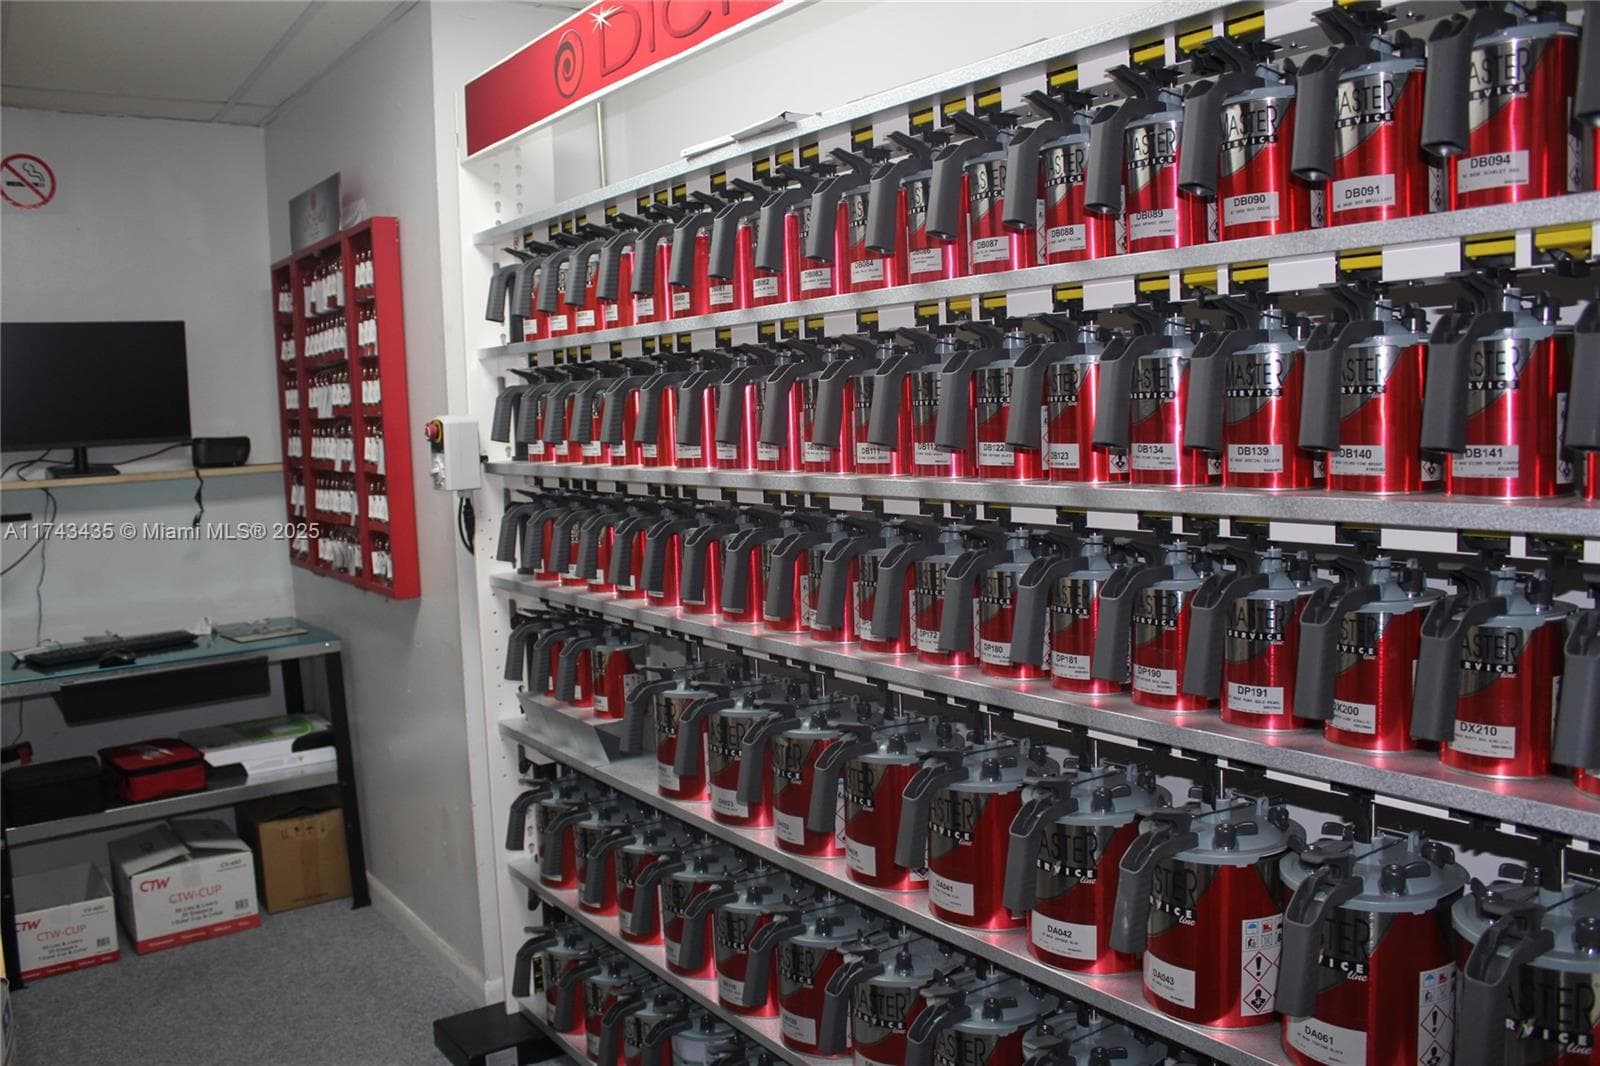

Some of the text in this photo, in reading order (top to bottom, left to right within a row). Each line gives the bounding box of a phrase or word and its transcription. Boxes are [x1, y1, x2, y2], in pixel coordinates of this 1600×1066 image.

[600, 0, 730, 77] DIC
[1469, 48, 1529, 86] ASTER
[1335, 81, 1394, 114] ASTER
[1336, 113, 1392, 127] ERVICE
[1133, 128, 1175, 159] ASTER
[1470, 155, 1510, 169] DB094
[1345, 185, 1381, 199] DB091
[1233, 195, 1266, 207] DB090
[1135, 210, 1163, 221] DB089
[1227, 388, 1283, 398] SERVICE
[1137, 445, 1164, 454] DB134
[1237, 447, 1269, 456] DB139
[1339, 449, 1372, 459] DB140
[1465, 448, 1503, 458] DB141
[1228, 630, 1282, 640] SERVICE
[1461, 632, 1518, 662] ASTER
[1137, 666, 1161, 678] DP190
[1464, 661, 1514, 673] RVICE
[1237, 685, 1268, 697] DP191
[1460, 722, 1498, 736] DX210
[929, 798, 974, 829] ASTER
[1037, 830, 1097, 866] ASTER
[1036, 859, 1094, 878] ERVICE
[139, 876, 170, 892] CTW
[1153, 865, 1198, 906] STER
[168, 884, 222, 904] CTW-CUP
[36, 924, 87, 942] CTW-CUP
[1047, 924, 1073, 938] DA042
[1152, 968, 1175, 985] DA043
[1304, 1025, 1334, 1045] DA061
[1505, 1018, 1587, 1046] RVICE
